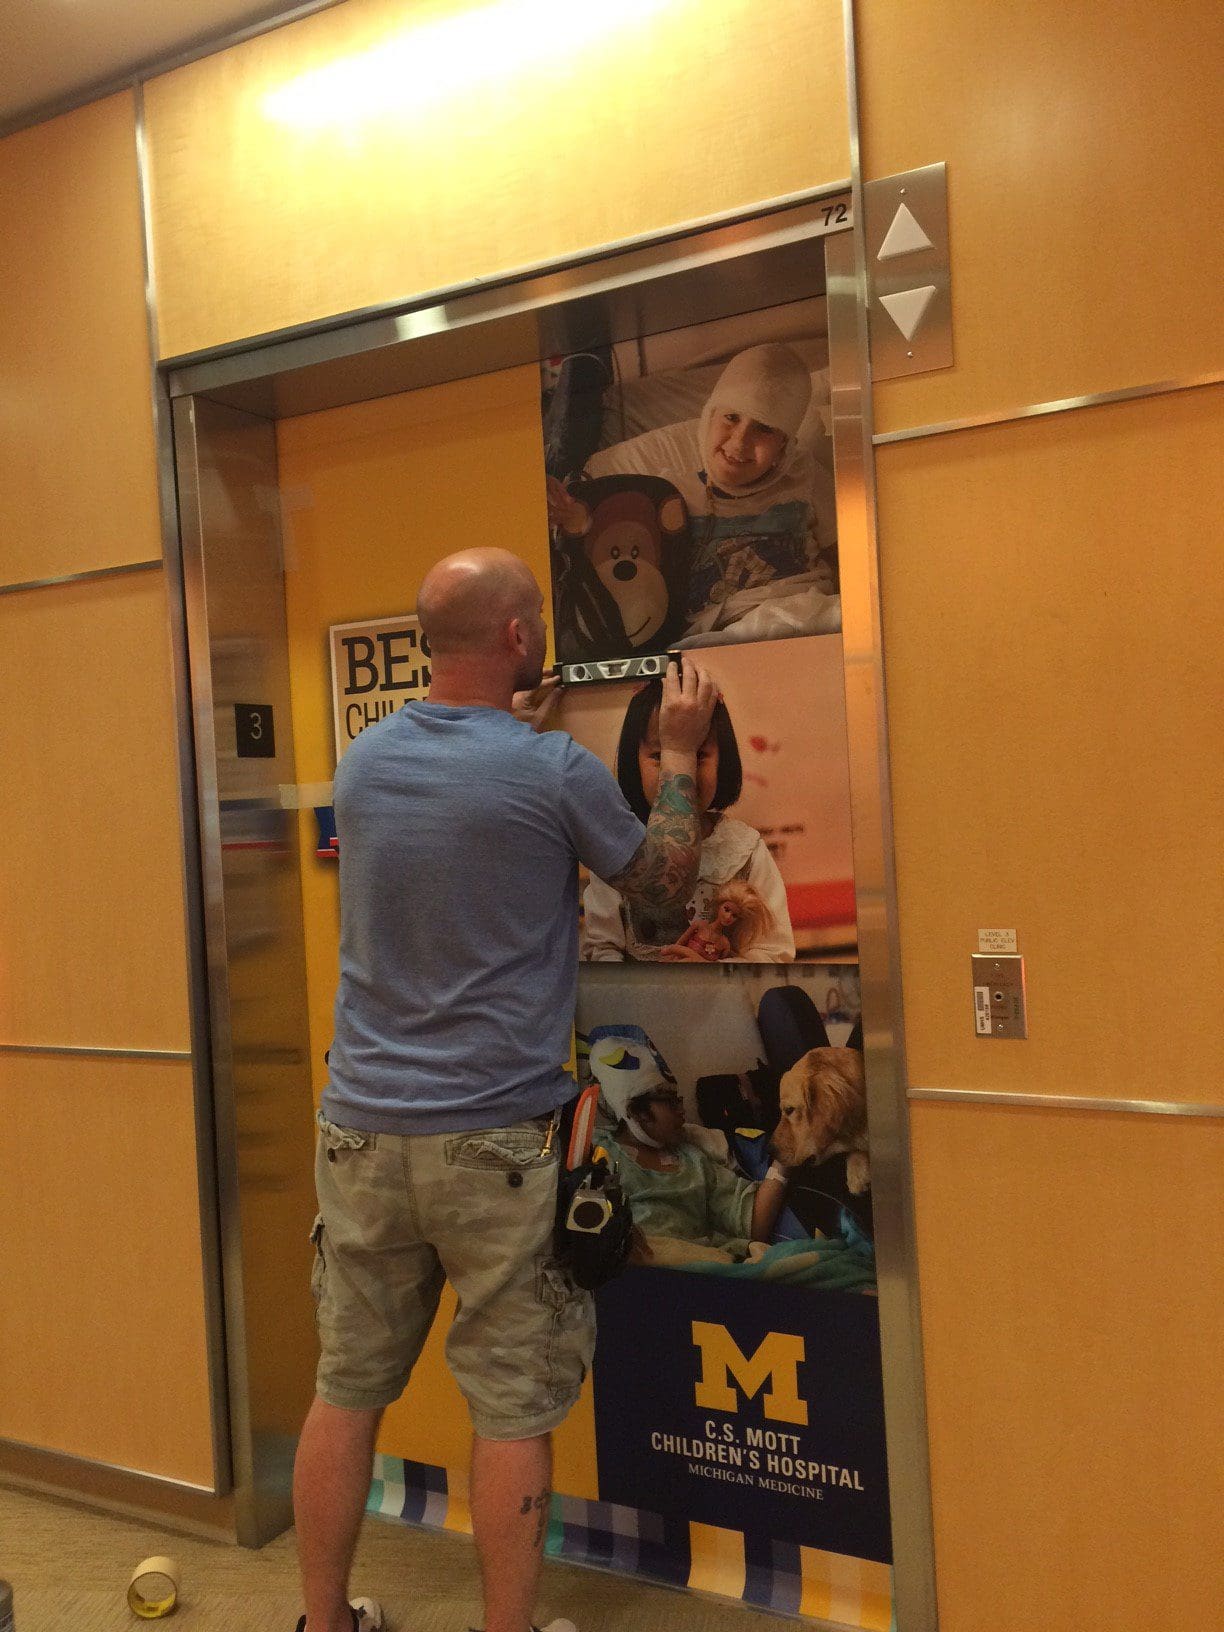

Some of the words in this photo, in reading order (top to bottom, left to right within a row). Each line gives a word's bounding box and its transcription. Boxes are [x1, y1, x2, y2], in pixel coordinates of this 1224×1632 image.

[821, 203, 848, 226] 72
[250, 712, 262, 739] 3
[692, 1320, 808, 1426] M
[705, 1420, 739, 1443] C.S.
[747, 1427, 801, 1455] MOTT
[651, 1431, 760, 1469] CHILDREN'S
[767, 1453, 864, 1491] HOSPITAL
[688, 1463, 754, 1485] MICHIGAN
[759, 1477, 824, 1500] MEDICINE
